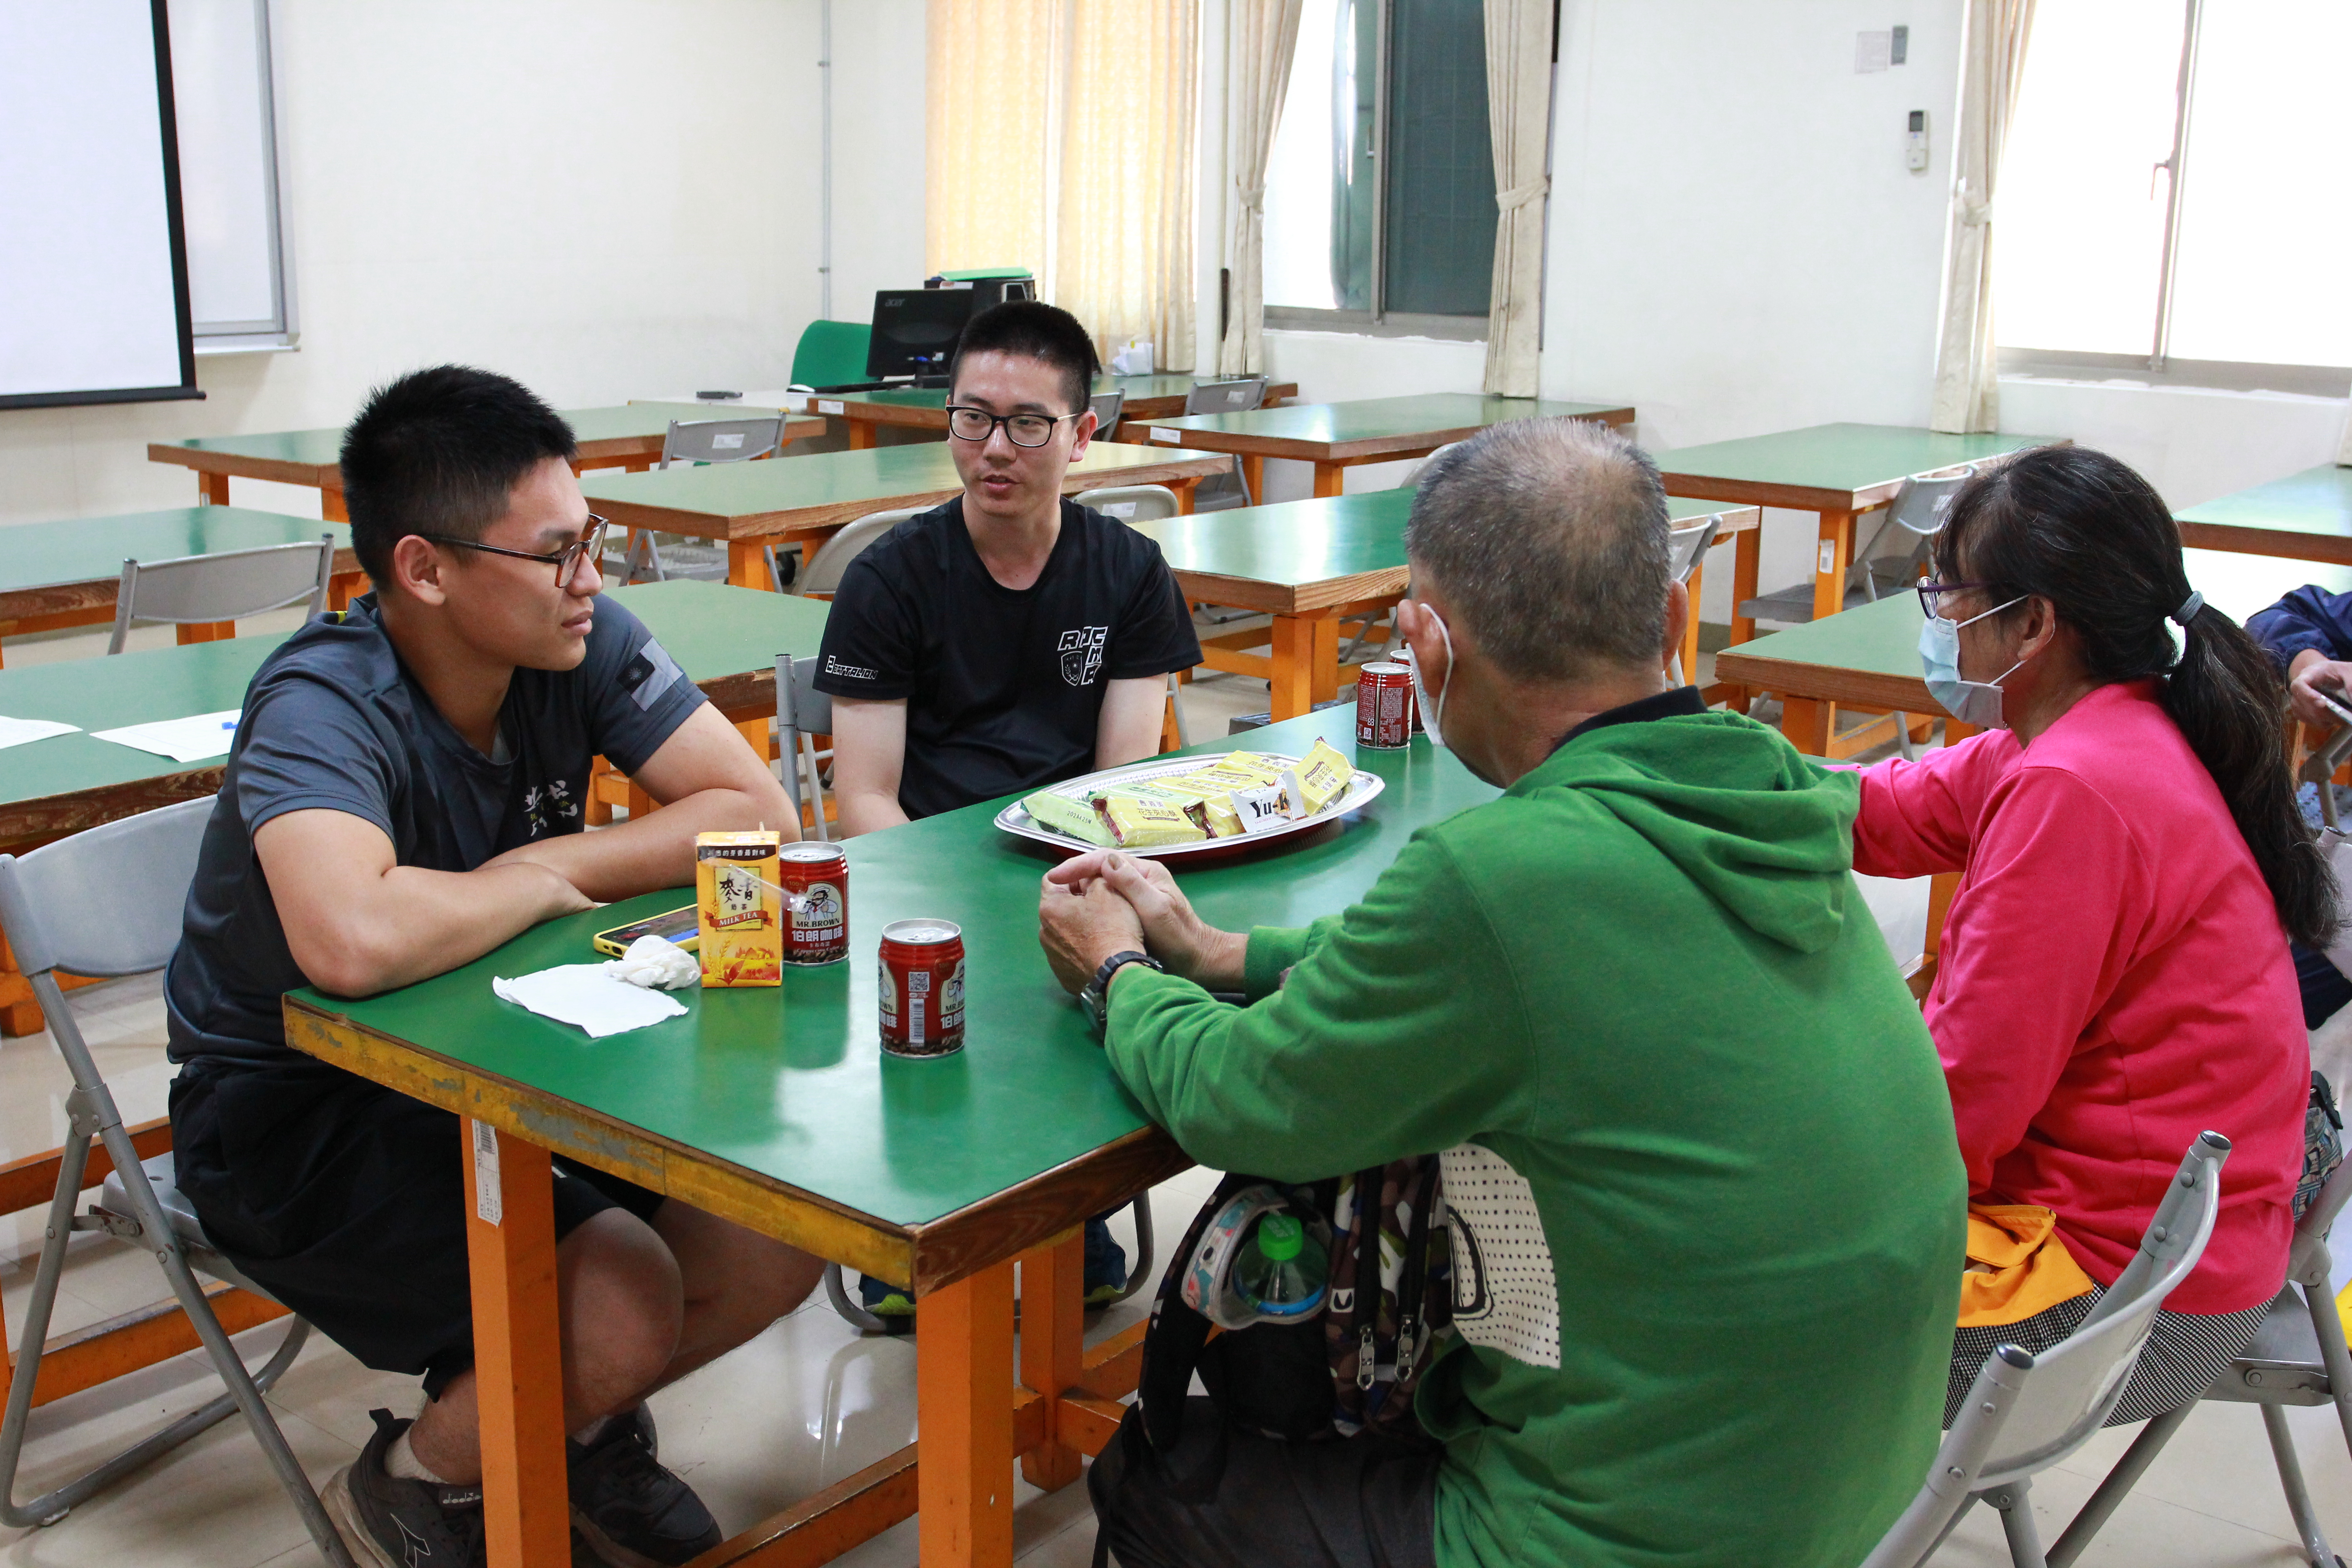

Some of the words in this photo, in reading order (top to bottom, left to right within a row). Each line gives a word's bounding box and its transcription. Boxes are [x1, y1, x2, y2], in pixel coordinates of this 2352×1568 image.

[719, 915, 740, 926] MILK
[796, 917, 840, 927] MR.BROWN
[792, 926, 843, 942] 伯朗咖啡
